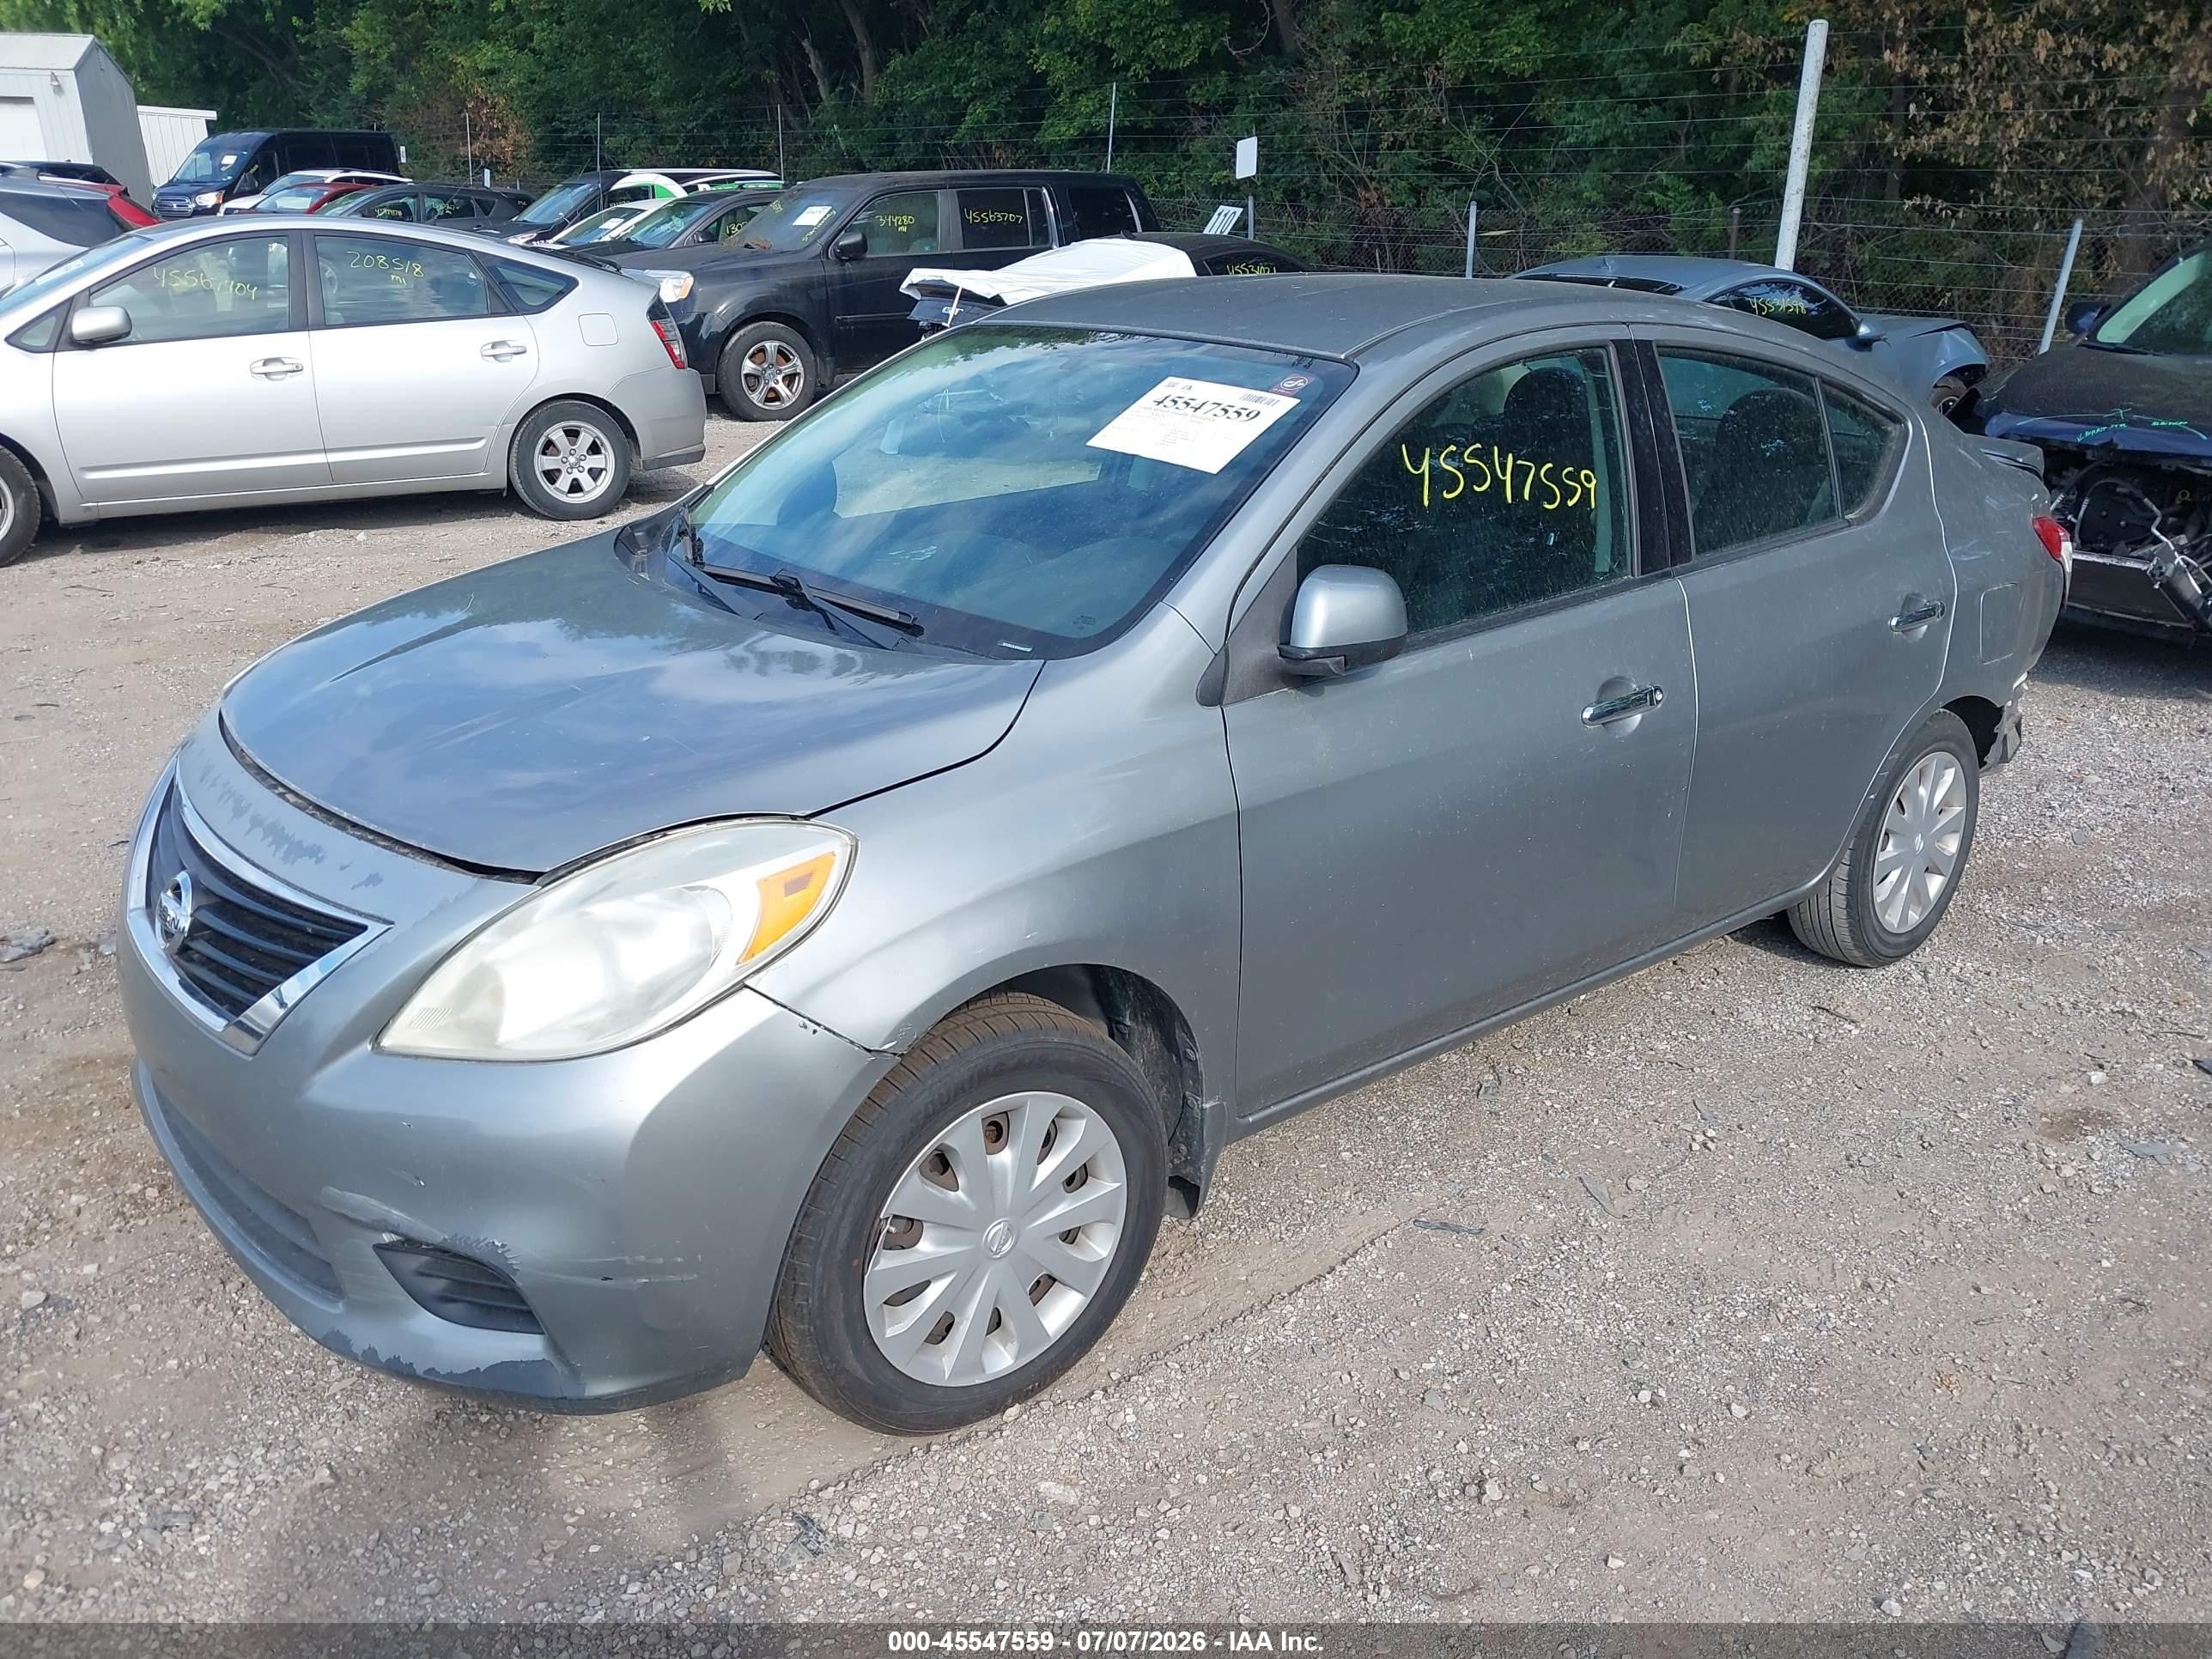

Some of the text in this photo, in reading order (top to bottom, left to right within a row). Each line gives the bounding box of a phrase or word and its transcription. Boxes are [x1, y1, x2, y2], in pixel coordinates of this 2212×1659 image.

[964, 208, 1024, 224] 45563707
[1207, 209, 1237, 234] 110
[346, 251, 424, 277] 208518
[1152, 394, 1261, 422] 45547559
[1401, 442, 1596, 510] 45547559
